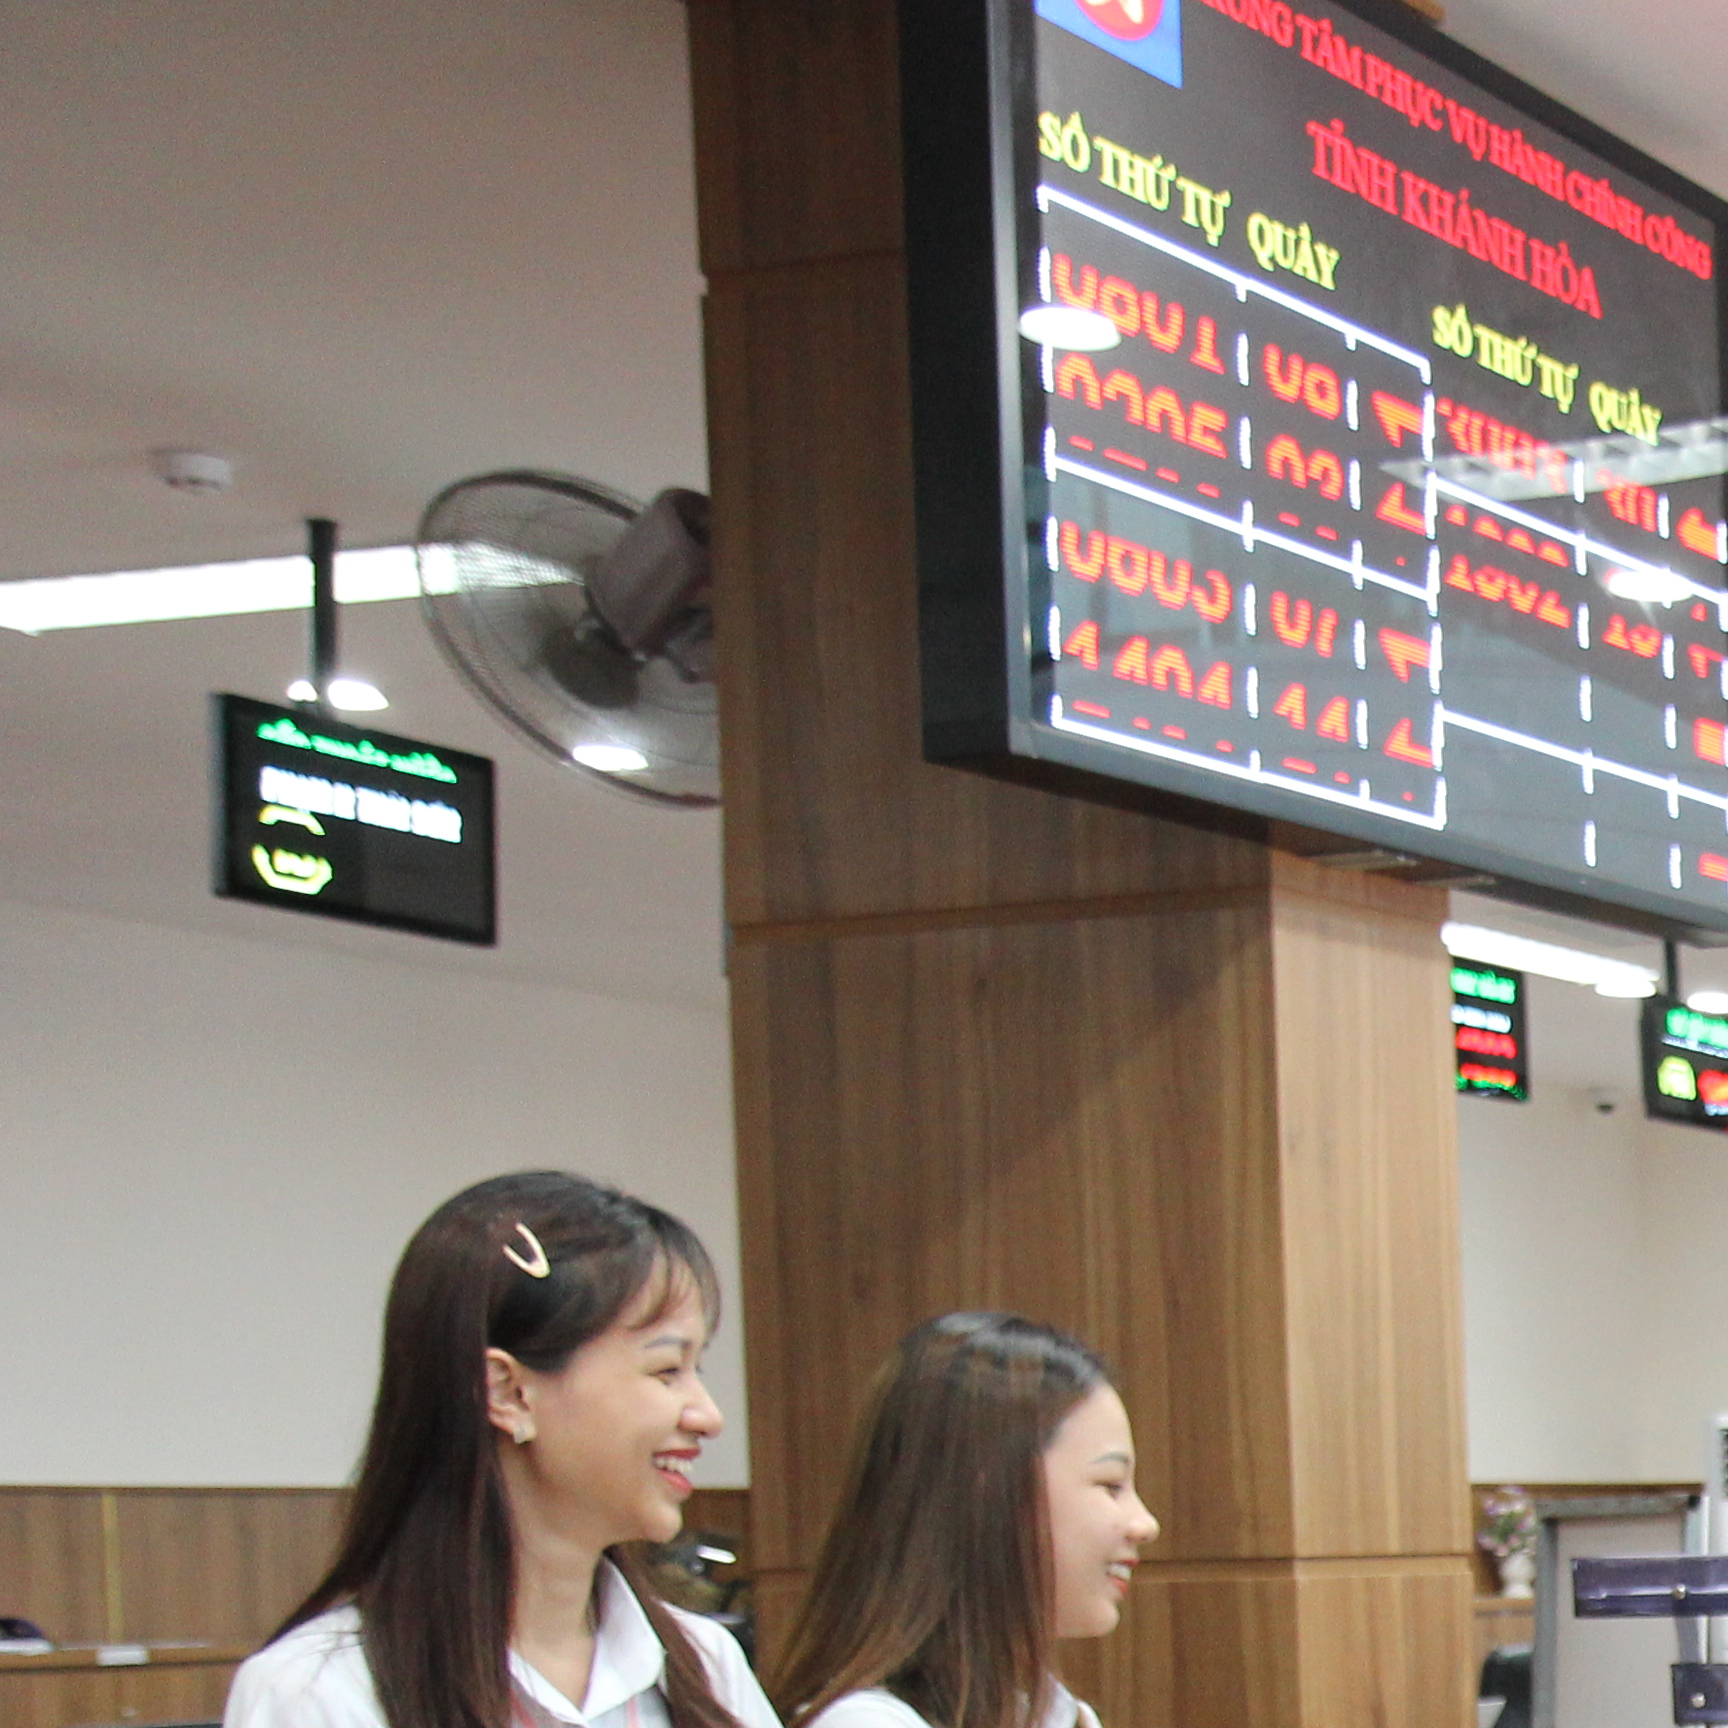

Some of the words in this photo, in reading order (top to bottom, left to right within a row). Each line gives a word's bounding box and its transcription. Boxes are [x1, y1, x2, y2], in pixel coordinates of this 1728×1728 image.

[1305, 117, 1399, 216] TỈNH
[1399, 170, 1527, 282] KHÁNH
[1364, 53, 1445, 131] PHỤC
[1444, 98, 1488, 162] VỤ
[1488, 124, 1566, 202] HÀNH
[1565, 169, 1645, 246] CHÍNH
[1175, 175, 1233, 248] TỰ
[1535, 353, 1580, 415] TỰ
